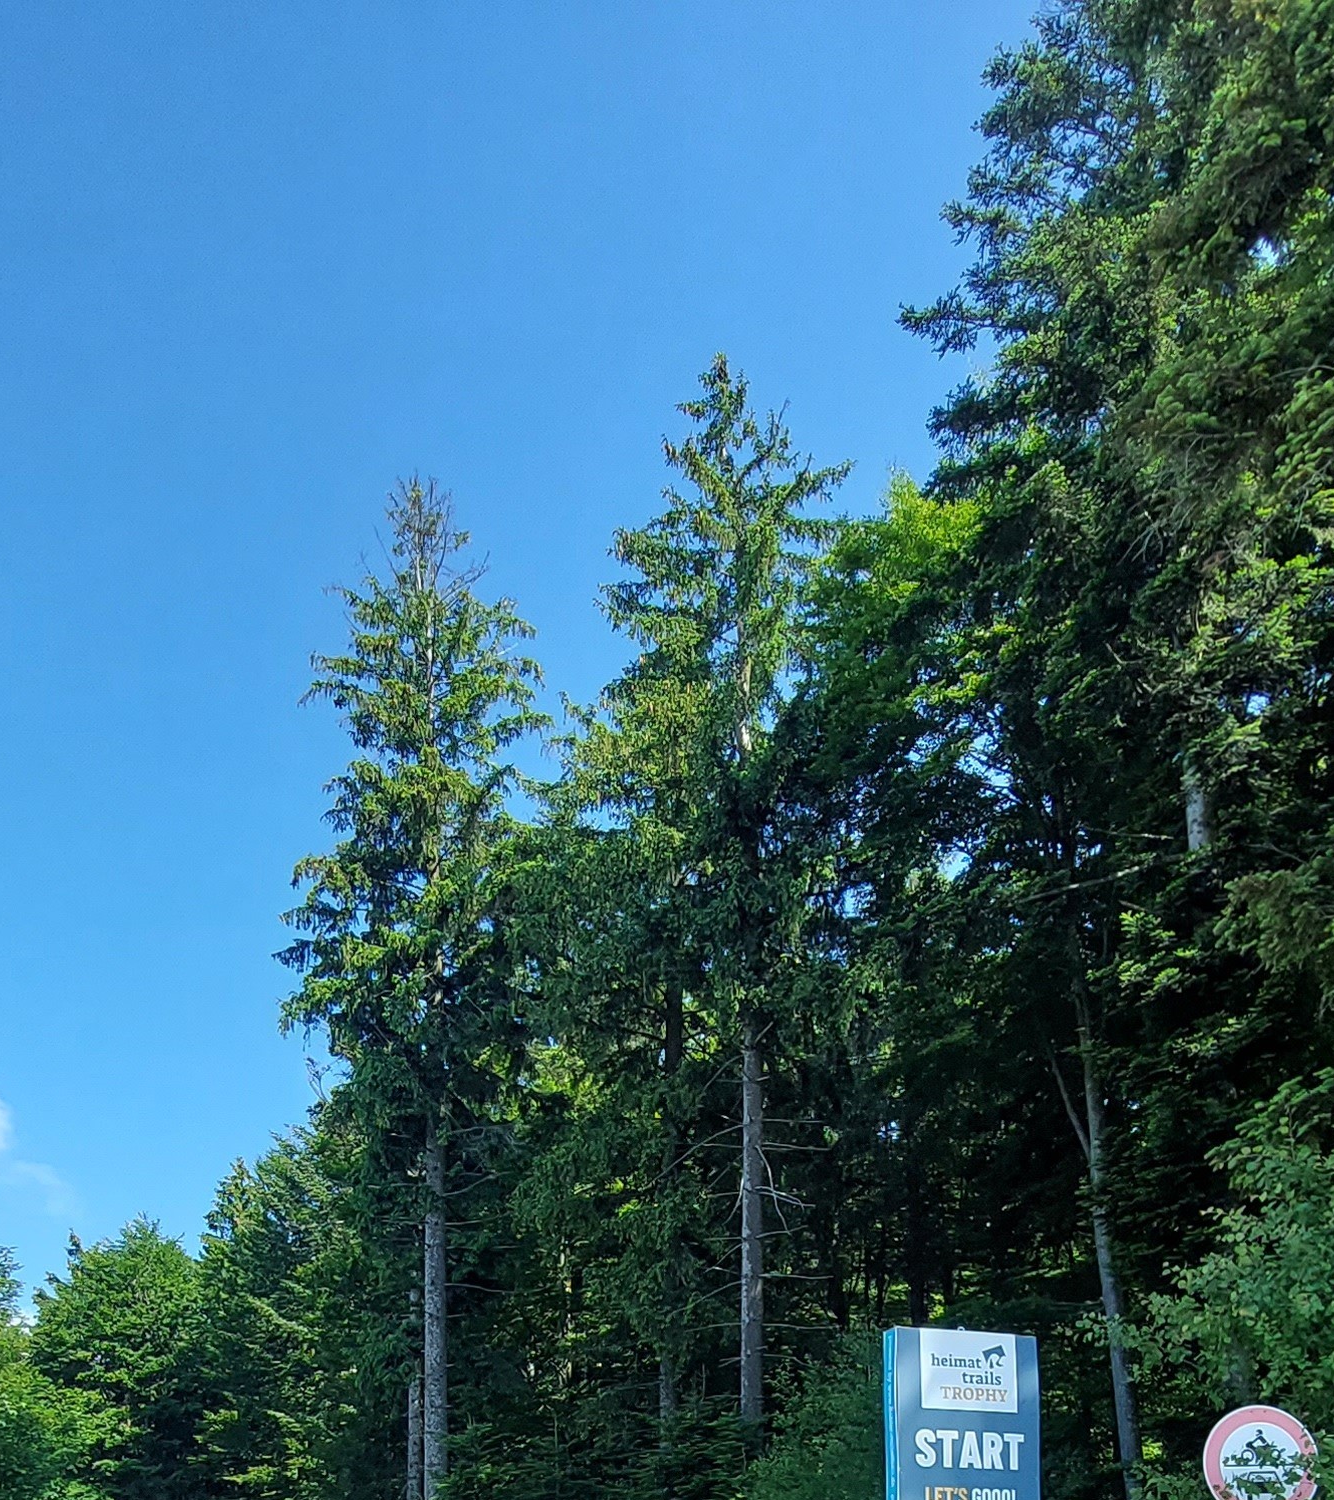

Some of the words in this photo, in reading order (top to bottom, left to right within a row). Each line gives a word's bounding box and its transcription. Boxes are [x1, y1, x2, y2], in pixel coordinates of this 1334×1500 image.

[931, 1353, 982, 1369] heimat
[962, 1371, 1002, 1386] trails
[940, 1386, 1008, 1402] TROPHY
[915, 1429, 1025, 1471] START
